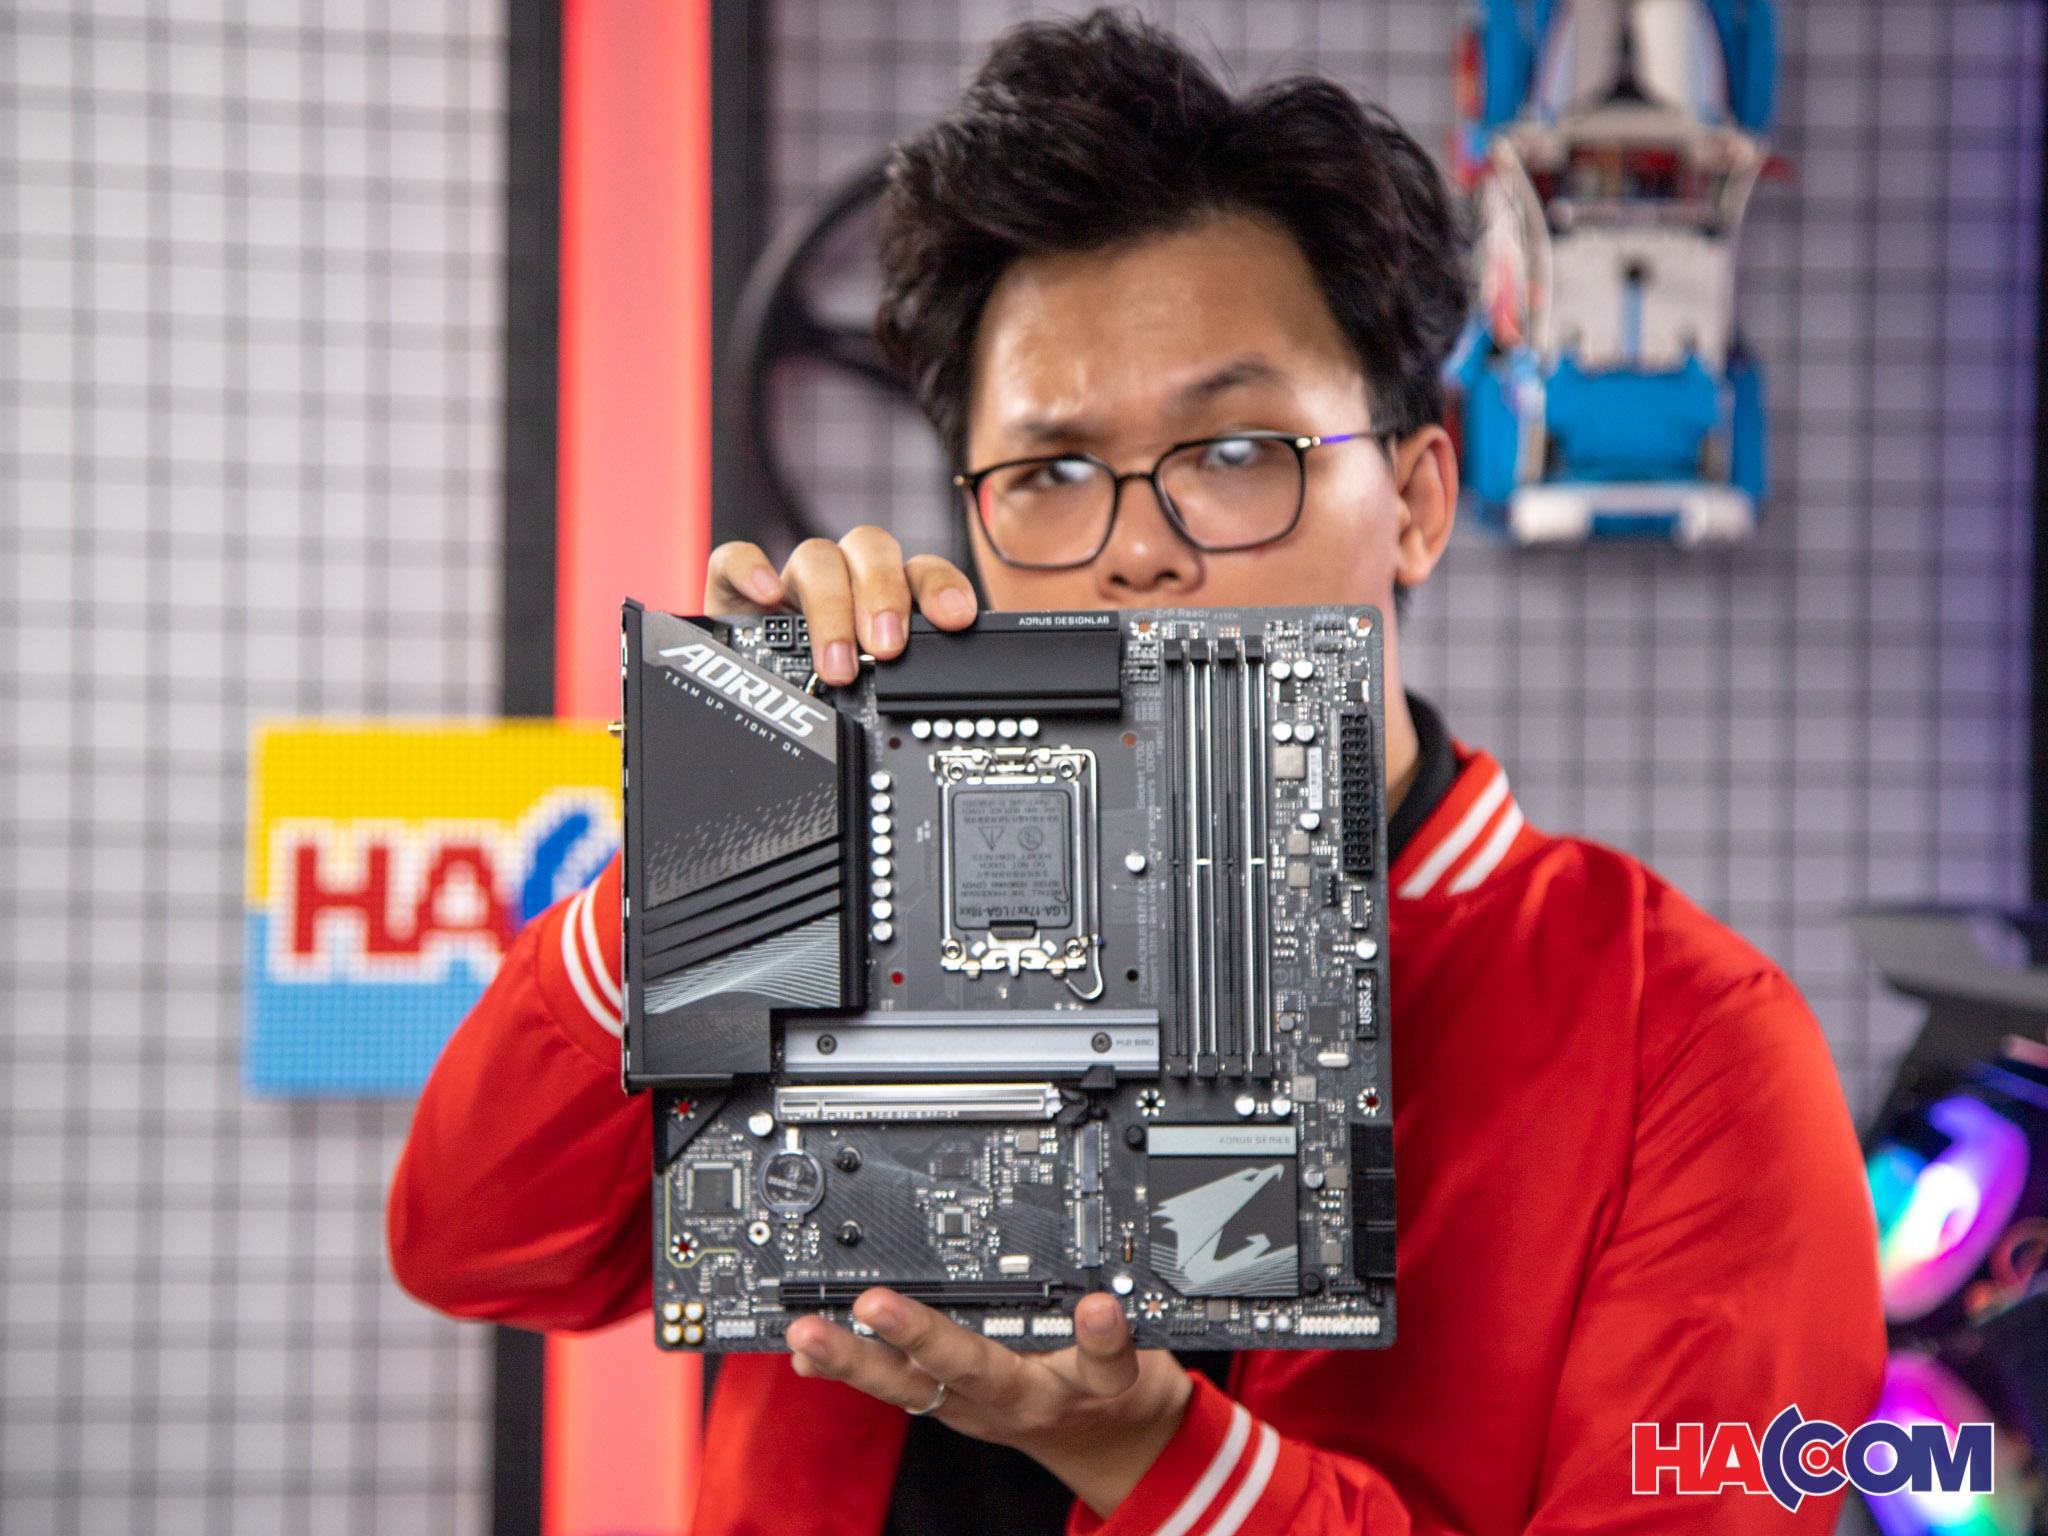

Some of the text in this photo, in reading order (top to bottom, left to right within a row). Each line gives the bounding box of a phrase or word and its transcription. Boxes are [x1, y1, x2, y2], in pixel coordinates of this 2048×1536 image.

[1019, 615, 1110, 626] AORUS DESIGNLAB
[658, 643, 829, 738] AORUS
[664, 671, 804, 761] TEAM UP. FIGHT ON.
[1358, 977, 1372, 1025] USB3.2
